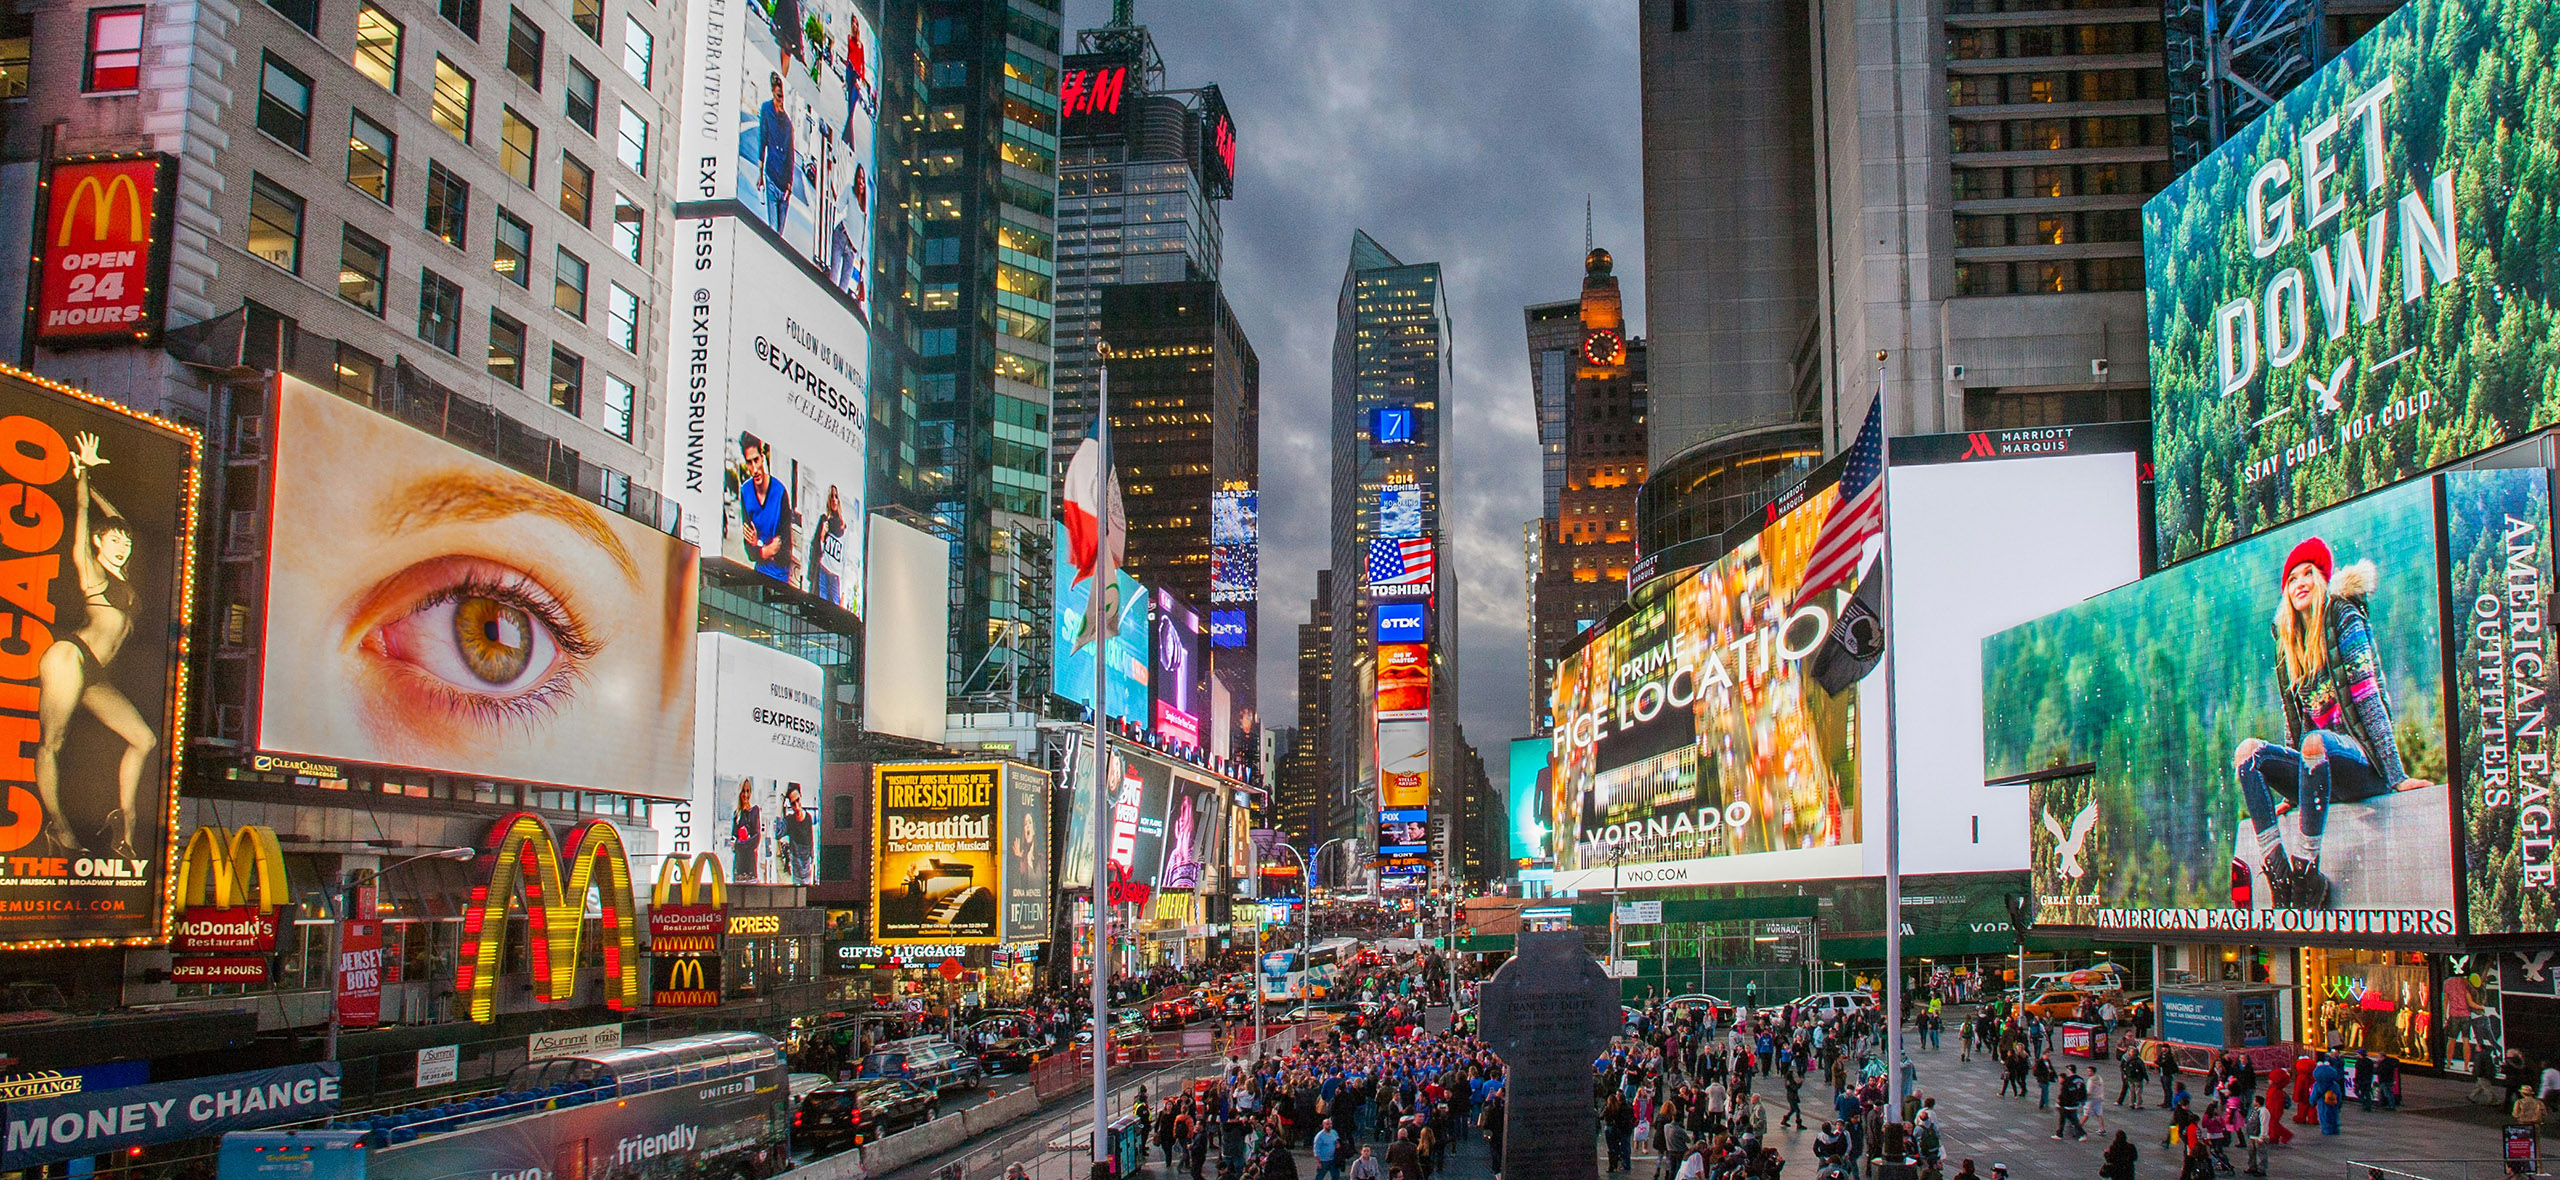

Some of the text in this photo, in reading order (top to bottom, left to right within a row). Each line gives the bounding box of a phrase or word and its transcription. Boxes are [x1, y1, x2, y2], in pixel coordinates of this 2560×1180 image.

[2246, 74, 2393, 259] GET
[62, 250, 136, 271] OPEN
[67, 272, 125, 303] 24
[2216, 169, 2460, 399] DOWN
[48, 305, 141, 326] HOURS
[786, 317, 844, 375] FOLLOW US ON
[686, 288, 711, 494] @EXPRESSRUNWAY
[2001, 429, 2073, 442] MARRIOTT
[2244, 389, 2440, 485] STAY COOL. NOT COLD.
[2002, 441, 2065, 453] MARQUIS
[1381, 483, 1420, 492] TOSHIBA
[1387, 475, 1414, 485] 2014
[1778, 480, 1807, 505] MARRIOTT
[1632, 555, 1658, 574] MARRIOTT
[1371, 583, 1430, 596] TOSHIBA
[0, 415, 71, 852] CHICAGO
[1390, 618, 1420, 628] TDK
[1620, 632, 1687, 687] PRIME
[2475, 593, 2510, 808] OUTFITTERS
[2504, 512, 2557, 888] AMERICAN EAGLE
[937, 775, 948, 784] THE
[970, 774, 979, 783] OF
[979, 774, 990, 783] THE
[1021, 793, 1034, 807] LIVE
[1116, 802, 1138, 824] HERO
[1382, 813, 1399, 822] FOX
[888, 814, 990, 840] Beautiful
[1586, 800, 1752, 851] VORNADO
[888, 841, 989, 853] The Carole King Musical
[1663, 837, 1718, 851] TRUST
[9, 857, 149, 878] THE ONLY
[1627, 868, 1688, 882] VNO.COM
[1107, 859, 1152, 920] Disney
[2040, 894, 2070, 906] GREAT
[1011, 900, 1043, 925] IF/THEN
[1155, 893, 1189, 921] FOREVER
[174, 920, 273, 936] McDonald's
[652, 914, 722, 924] McDonald's
[2101, 908, 2454, 935] AMERICAN EAGLE OUTFITTERS
[188, 938, 254, 947] Restaurant
[839, 945, 966, 957] GIFTS LUGGAGE
[173, 965, 262, 975] OPEN 24 HOURS
[340, 949, 384, 972] JERSEY
[346, 968, 379, 991] BOYS
[700, 1083, 743, 1099] UNITED
[7, 1076, 341, 1151] MONEY CHANGE
[618, 1123, 699, 1165] friendly
